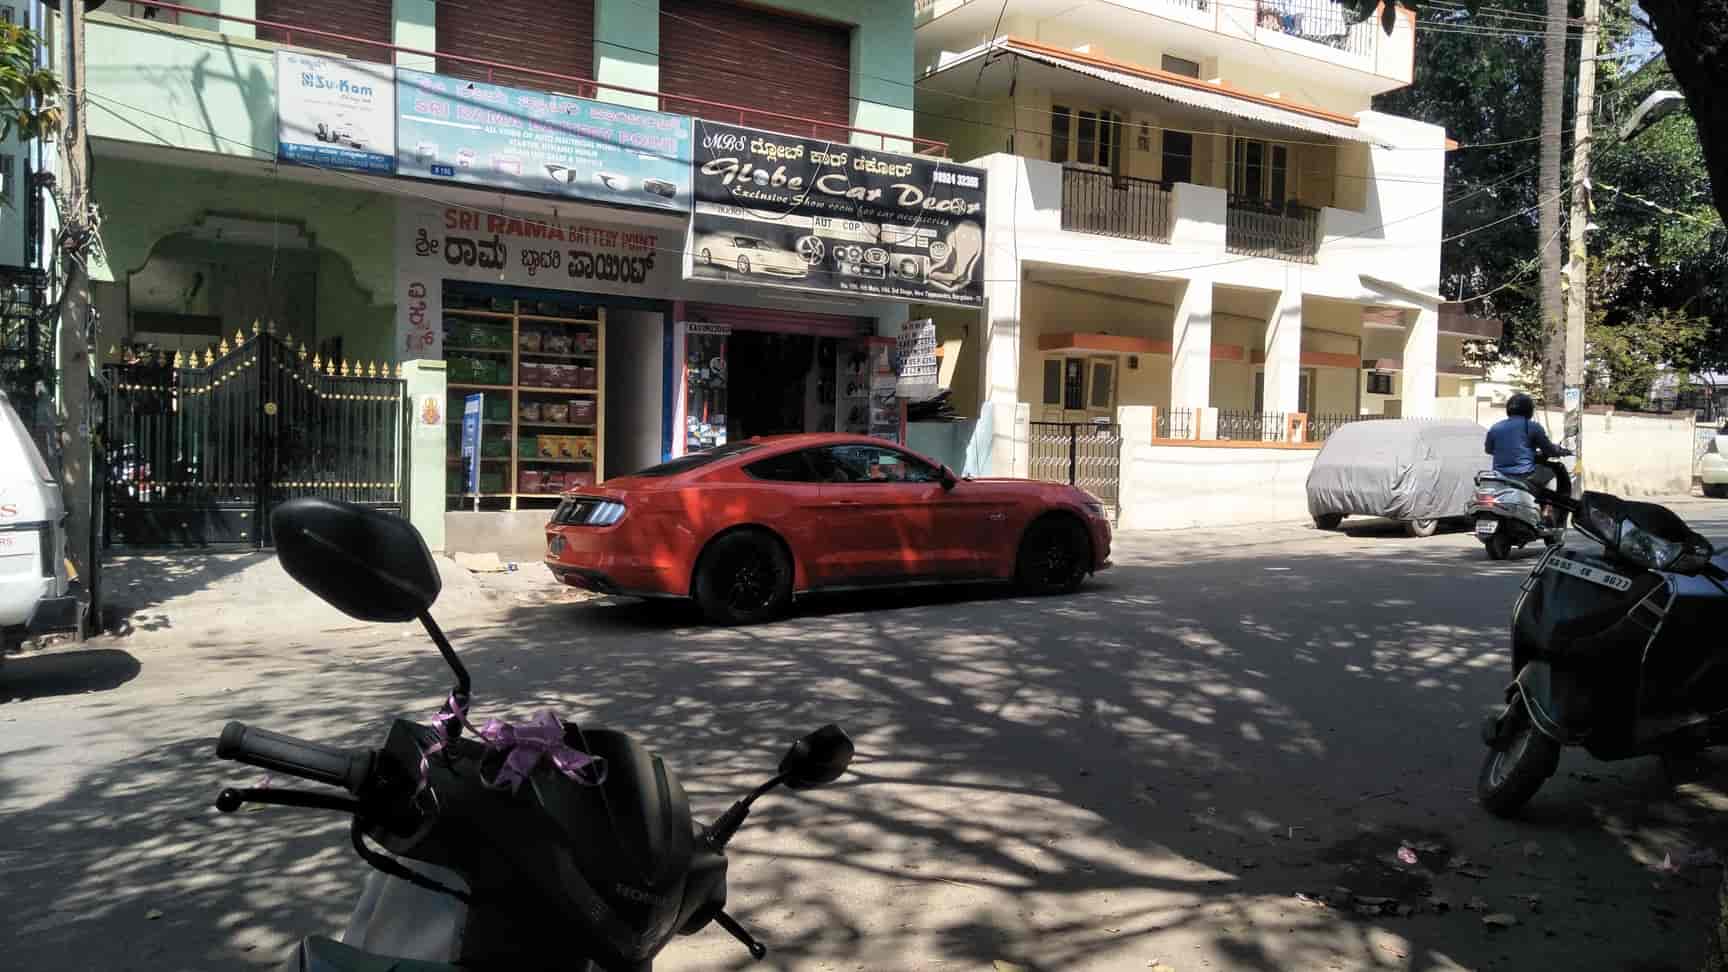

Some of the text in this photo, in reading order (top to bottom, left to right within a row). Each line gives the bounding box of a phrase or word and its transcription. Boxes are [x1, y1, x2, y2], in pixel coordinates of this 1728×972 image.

[703, 134, 747, 152] MBS
[701, 157, 803, 190] Globe
[816, 173, 881, 201] Car
[732, 185, 788, 203] Exclusive
[444, 208, 480, 233] SRI
[487, 213, 565, 242] RAMA
[568, 225, 619, 249] BATTERY
